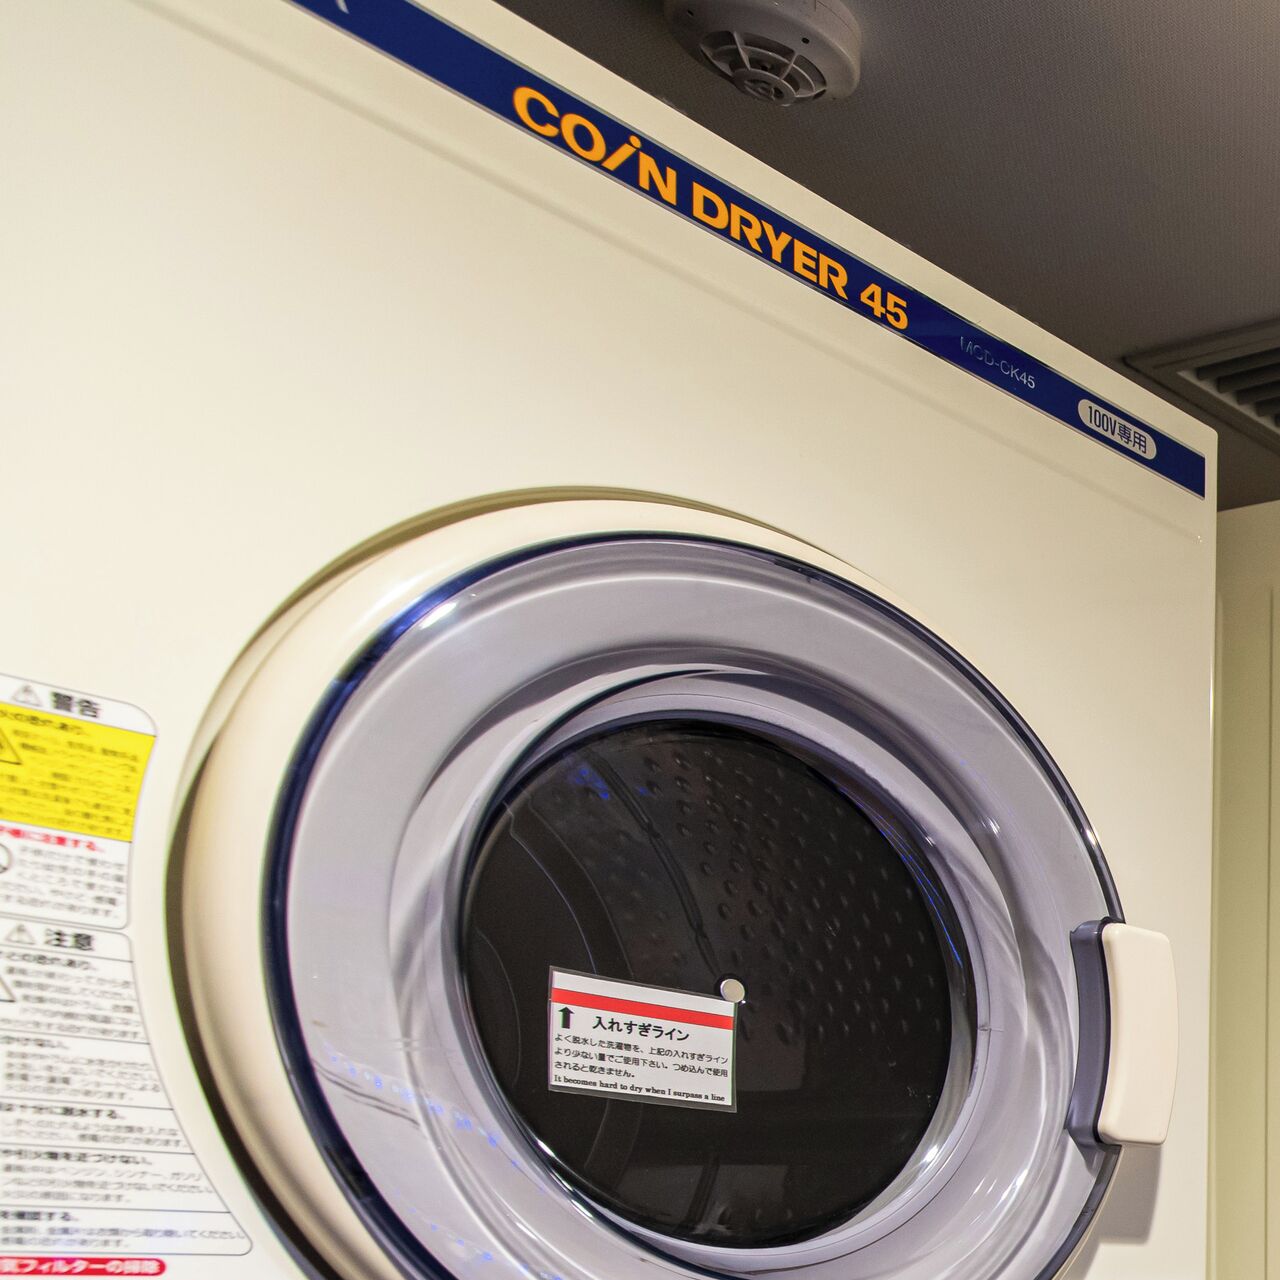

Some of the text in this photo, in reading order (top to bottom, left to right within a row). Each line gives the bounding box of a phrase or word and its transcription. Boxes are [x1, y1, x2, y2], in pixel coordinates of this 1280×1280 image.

[693, 191, 848, 299] DRYER
[860, 284, 908, 331] 45
[960, 335, 1036, 390] MCD-CK45
[1087, 405, 1148, 455] 100V専用
[593, 1016, 689, 1041] 入れすぎライン
[563, 1076, 597, 1087] becomes
[599, 1080, 618, 1089] hard
[629, 1084, 643, 1093] dry
[645, 1086, 665, 1095] when
[673, 1090, 702, 1100] surpass
